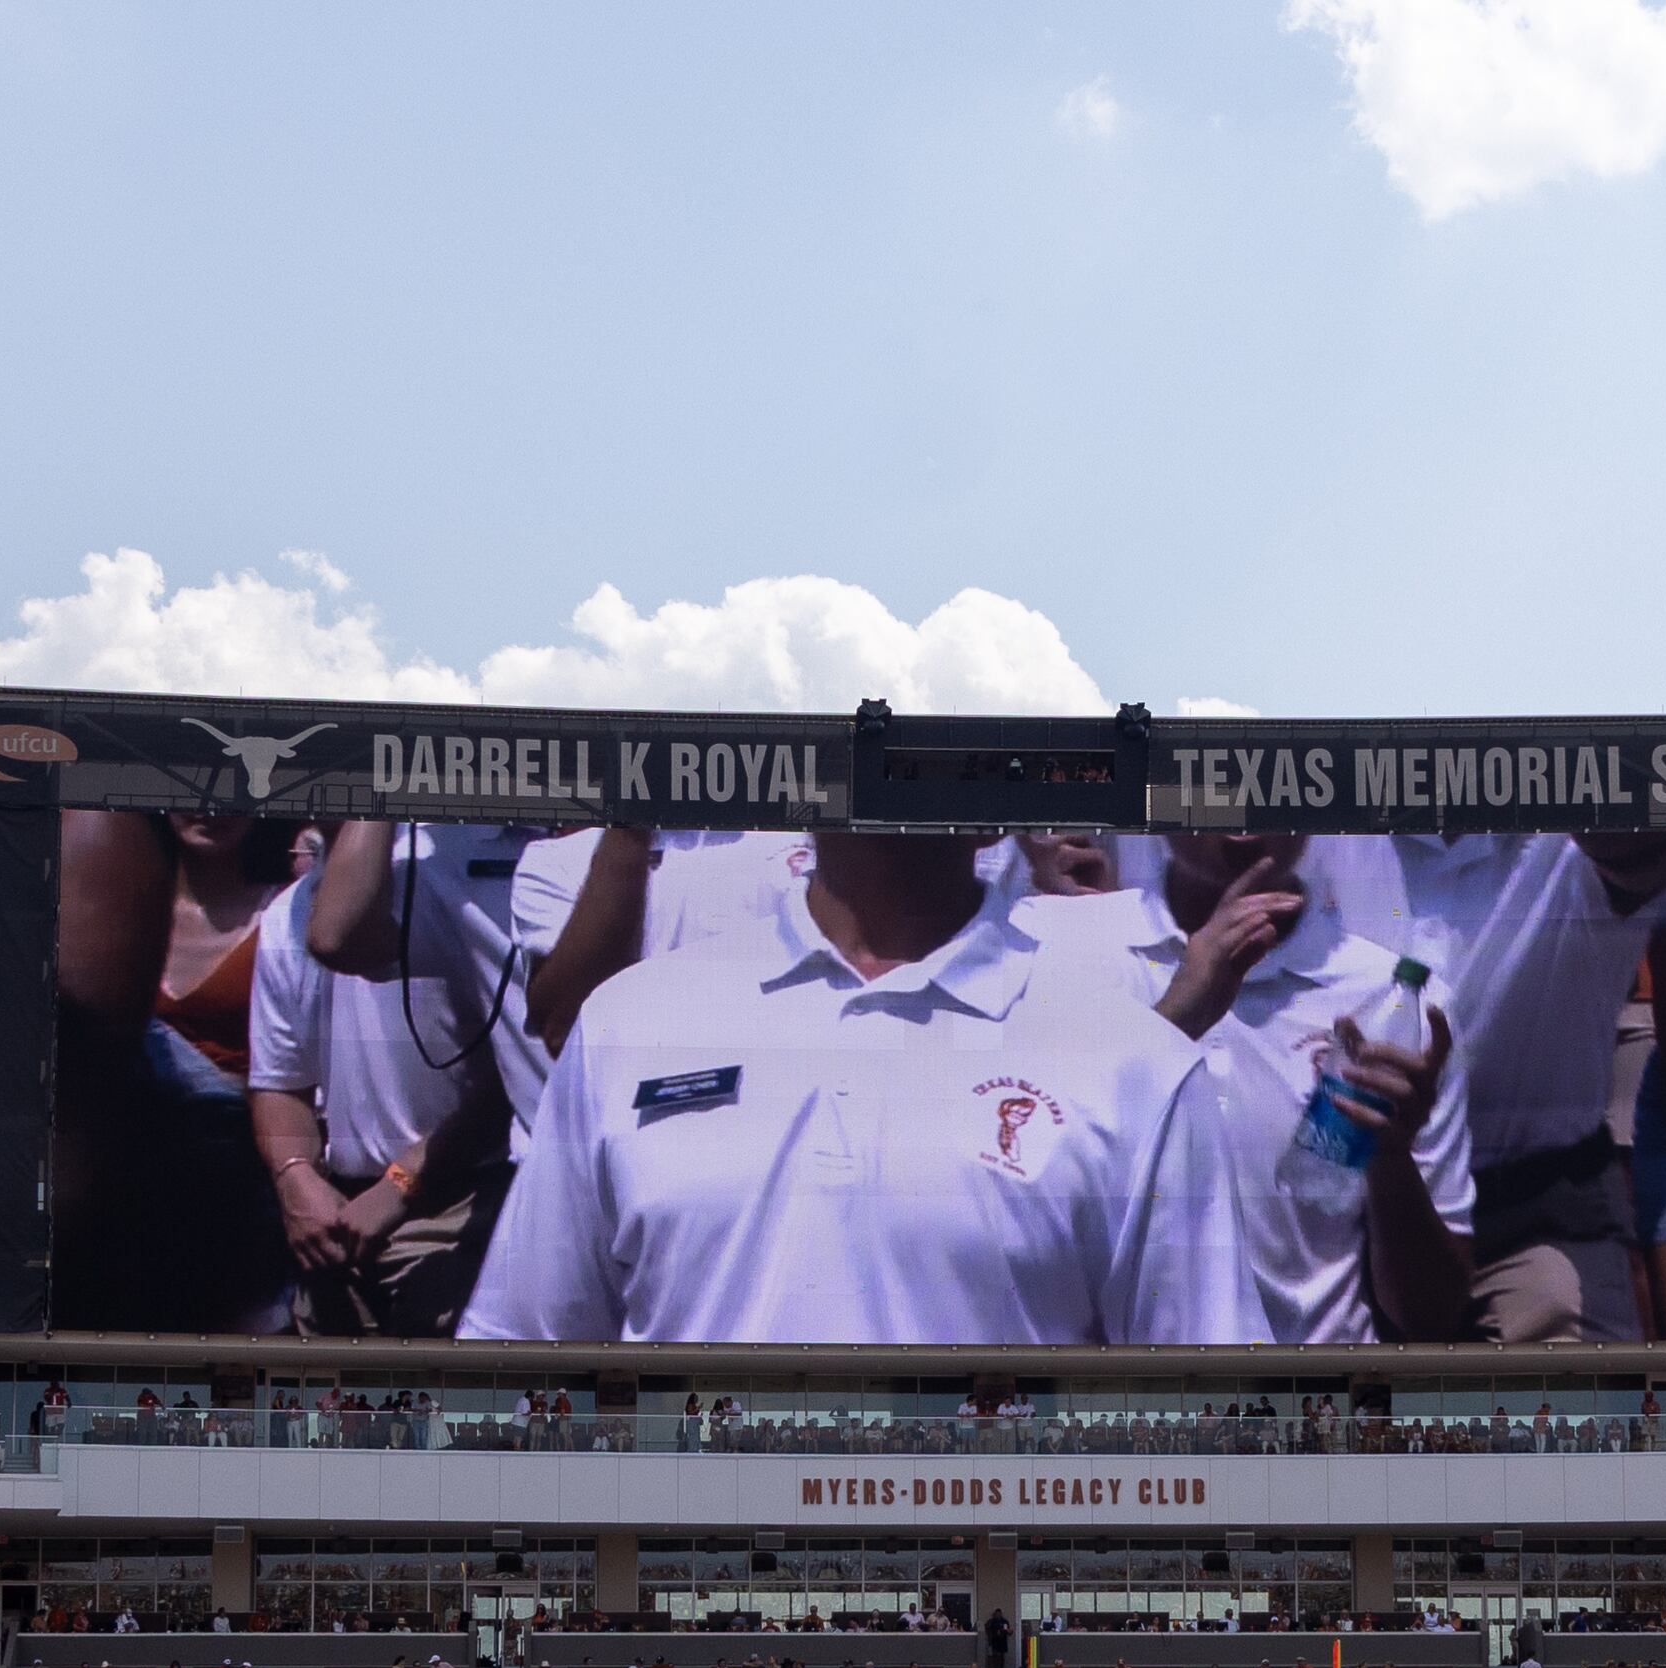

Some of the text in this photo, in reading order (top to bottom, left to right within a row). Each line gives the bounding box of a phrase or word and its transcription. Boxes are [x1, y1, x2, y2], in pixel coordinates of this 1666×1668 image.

[3, 732, 57, 753] ufcu
[373, 734, 828, 803] DARRELL K ROYAL
[1173, 747, 1333, 807] TEXAS
[1355, 745, 1632, 807] MEMORIAL
[1019, 1478, 1121, 1505] LEGACY
[1138, 1478, 1206, 1505] CLUB
